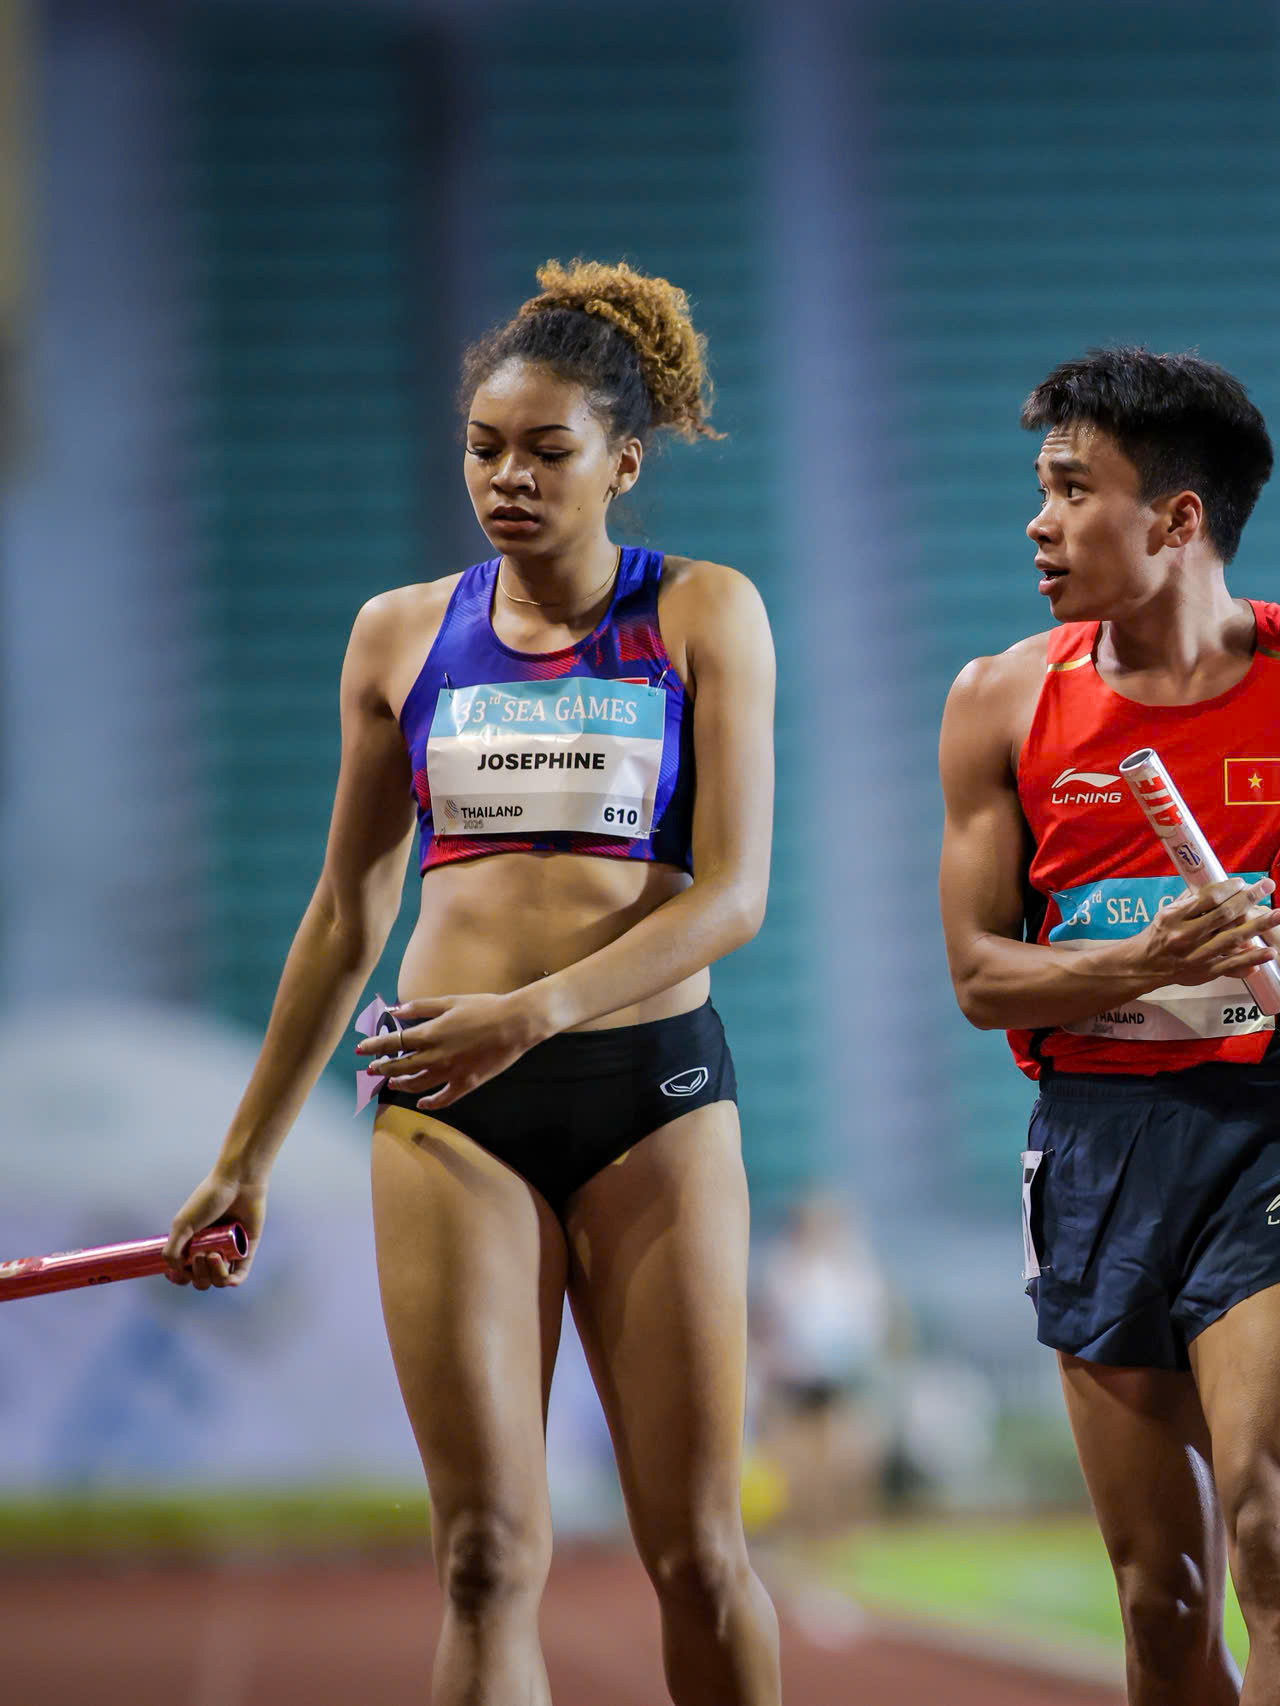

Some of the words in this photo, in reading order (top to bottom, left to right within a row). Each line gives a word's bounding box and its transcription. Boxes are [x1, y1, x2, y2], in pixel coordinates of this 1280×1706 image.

[502, 698, 546, 723] SEA
[555, 695, 638, 725] GAMES
[477, 752, 606, 771] JOSEPHINE
[1051, 792, 1122, 805] LI-NING
[461, 805, 523, 819] THAILAND
[603, 807, 638, 825] 610
[1106, 897, 1151, 925] SEA
[1223, 1005, 1261, 1025] 284
